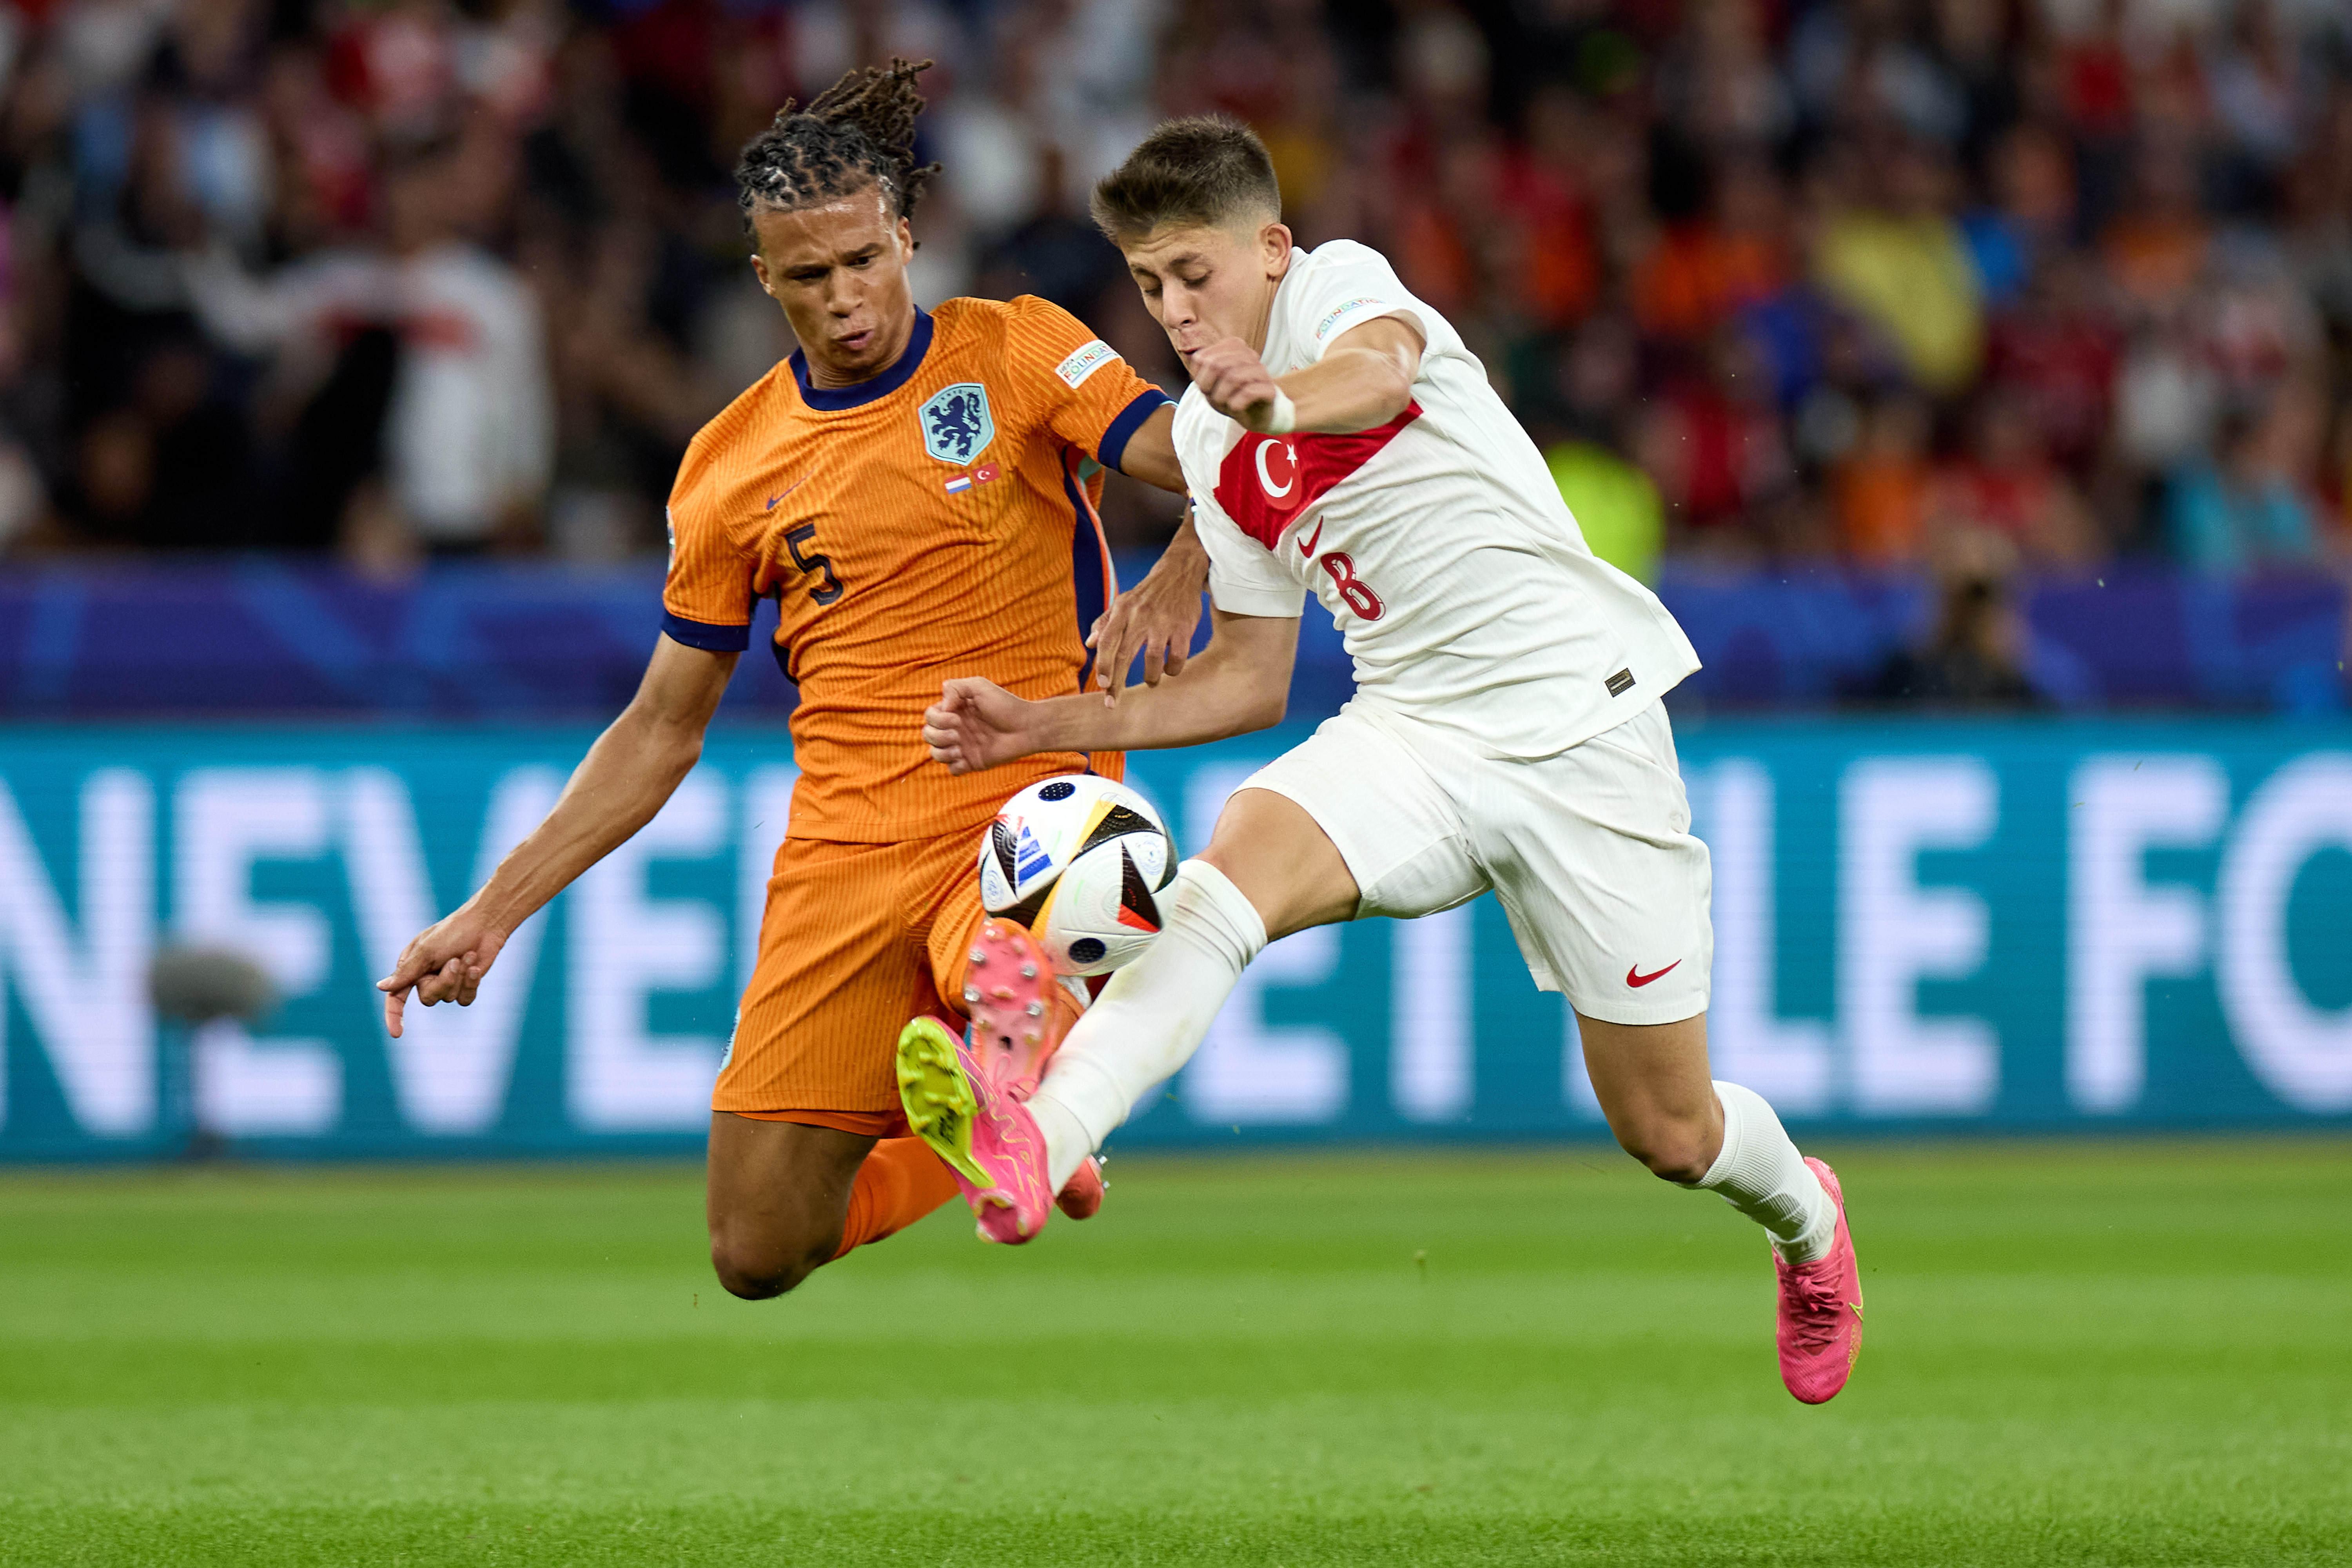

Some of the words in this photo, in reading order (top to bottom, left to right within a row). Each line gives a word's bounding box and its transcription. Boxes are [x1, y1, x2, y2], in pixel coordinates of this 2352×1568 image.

[1316, 299, 1387, 341] FOUNDATIO
[785, 523, 844, 606] 5
[1320, 552, 1386, 621] 8
[0, 766, 796, 1133] NEVE
